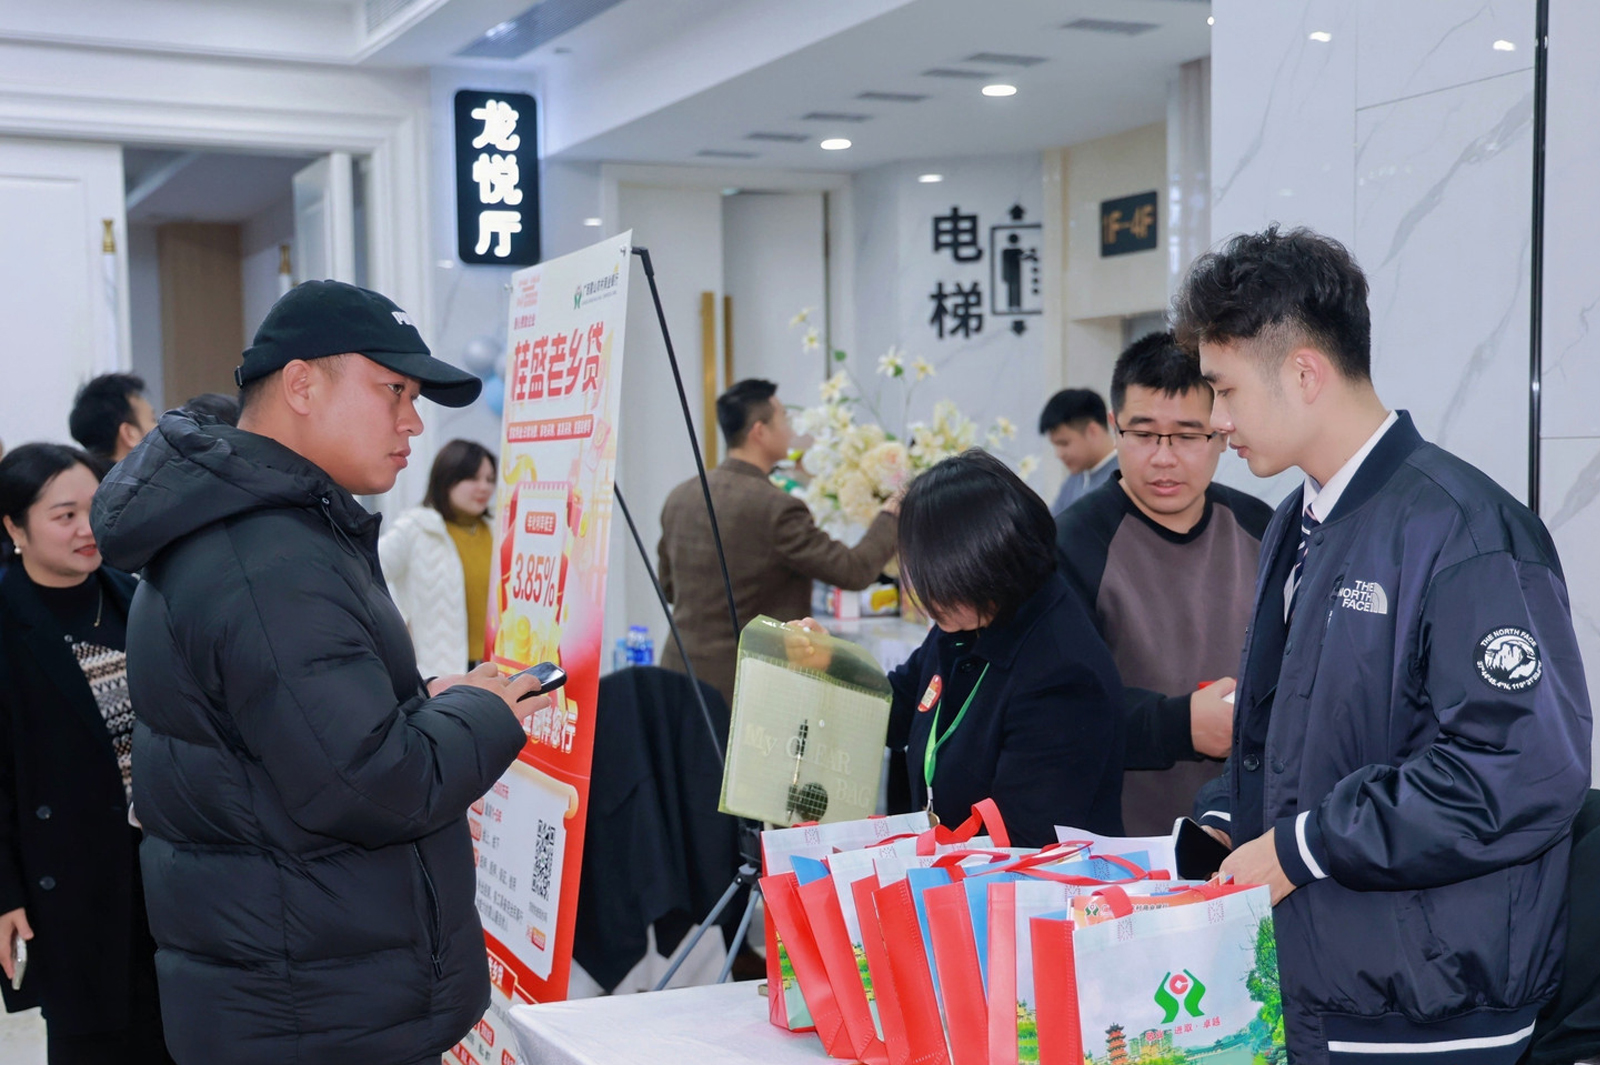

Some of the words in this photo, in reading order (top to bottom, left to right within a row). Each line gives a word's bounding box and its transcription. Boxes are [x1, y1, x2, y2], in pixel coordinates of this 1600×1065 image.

[471, 99, 523, 258] 龙悦厅
[930, 206, 984, 338] 电梯
[511, 320, 604, 402] 桂盛老乡贷
[513, 552, 556, 608] 3.85%
[1342, 598, 1373, 612] FACE
[1355, 580, 1374, 592] THE
[1480, 633, 1495, 647] THE
[1493, 628, 1520, 638] NORTH
[1520, 631, 1537, 647] FACE
